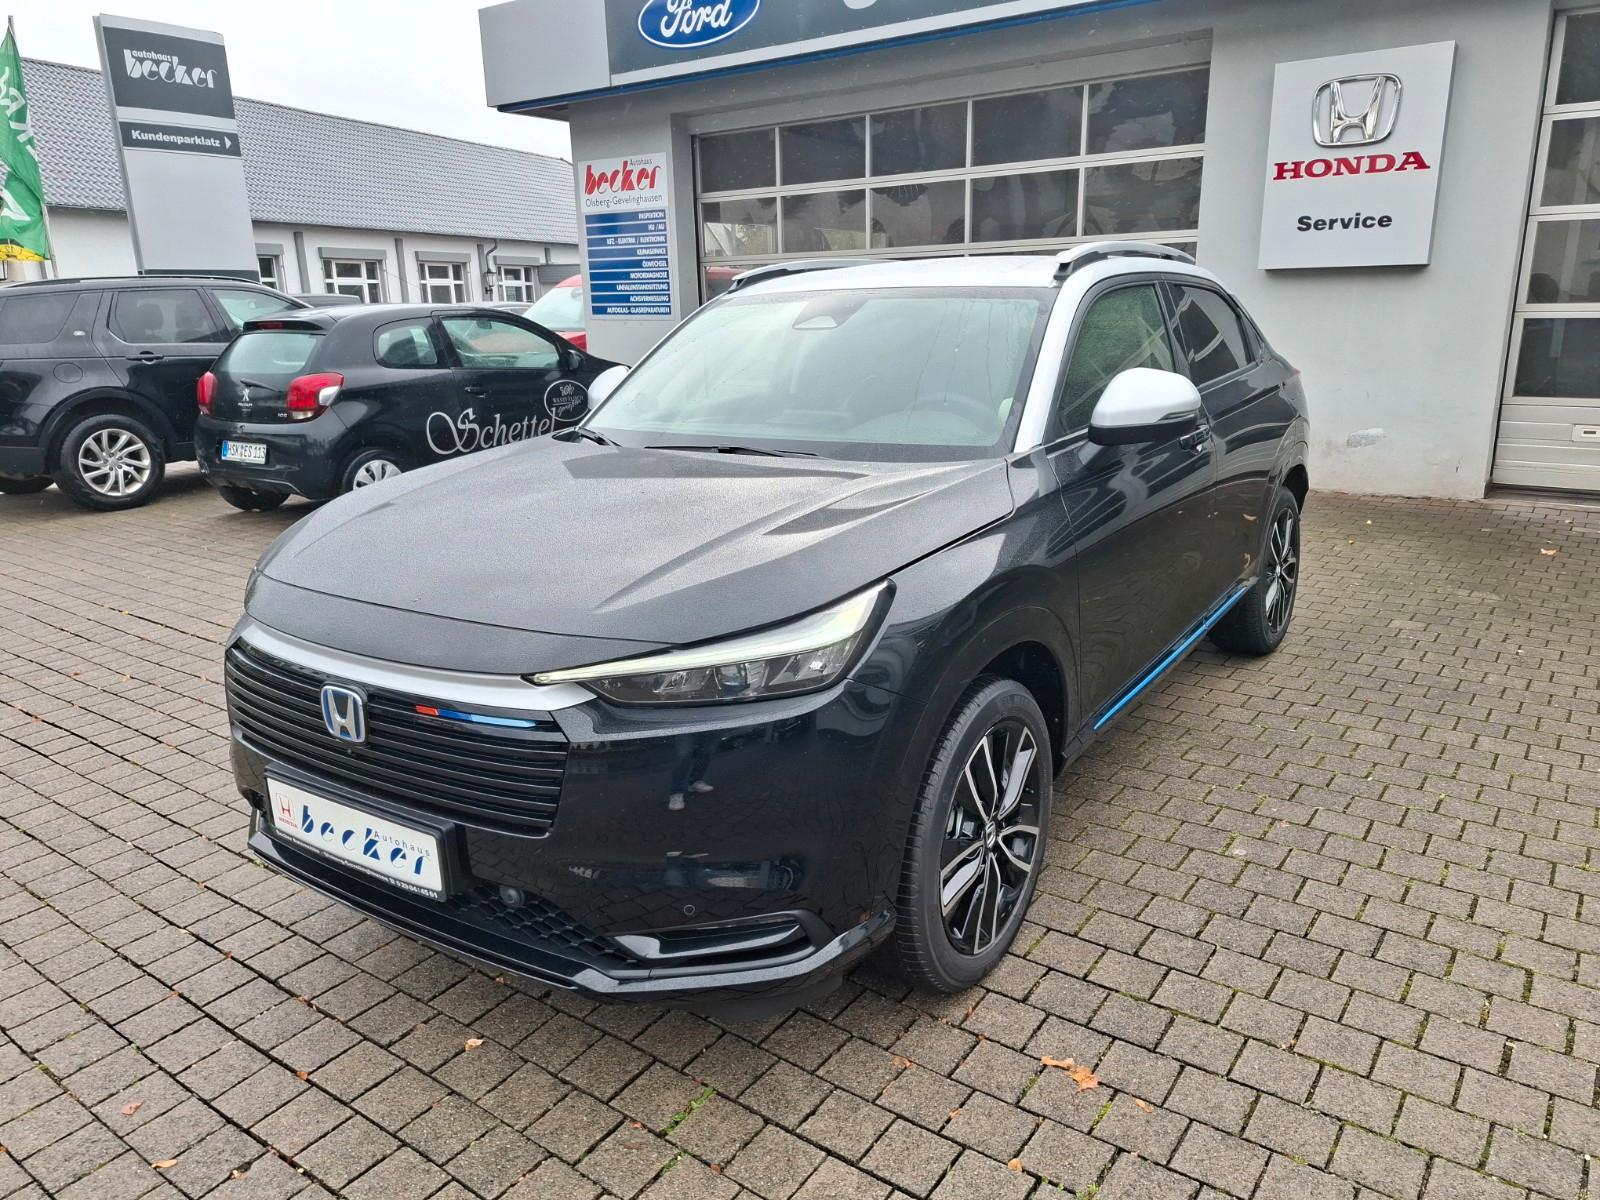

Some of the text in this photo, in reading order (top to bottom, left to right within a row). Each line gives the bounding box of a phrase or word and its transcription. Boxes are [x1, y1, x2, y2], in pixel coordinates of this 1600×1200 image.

[660, 0, 733, 38] Ford
[123, 48, 218, 89] becker
[132, 49, 171, 61] autohaus
[585, 160, 661, 195] becker
[1272, 151, 1431, 181] HONDA
[1297, 212, 1393, 232] Service
[302, 805, 432, 875] becker
[374, 831, 430, 857] Autohaus
